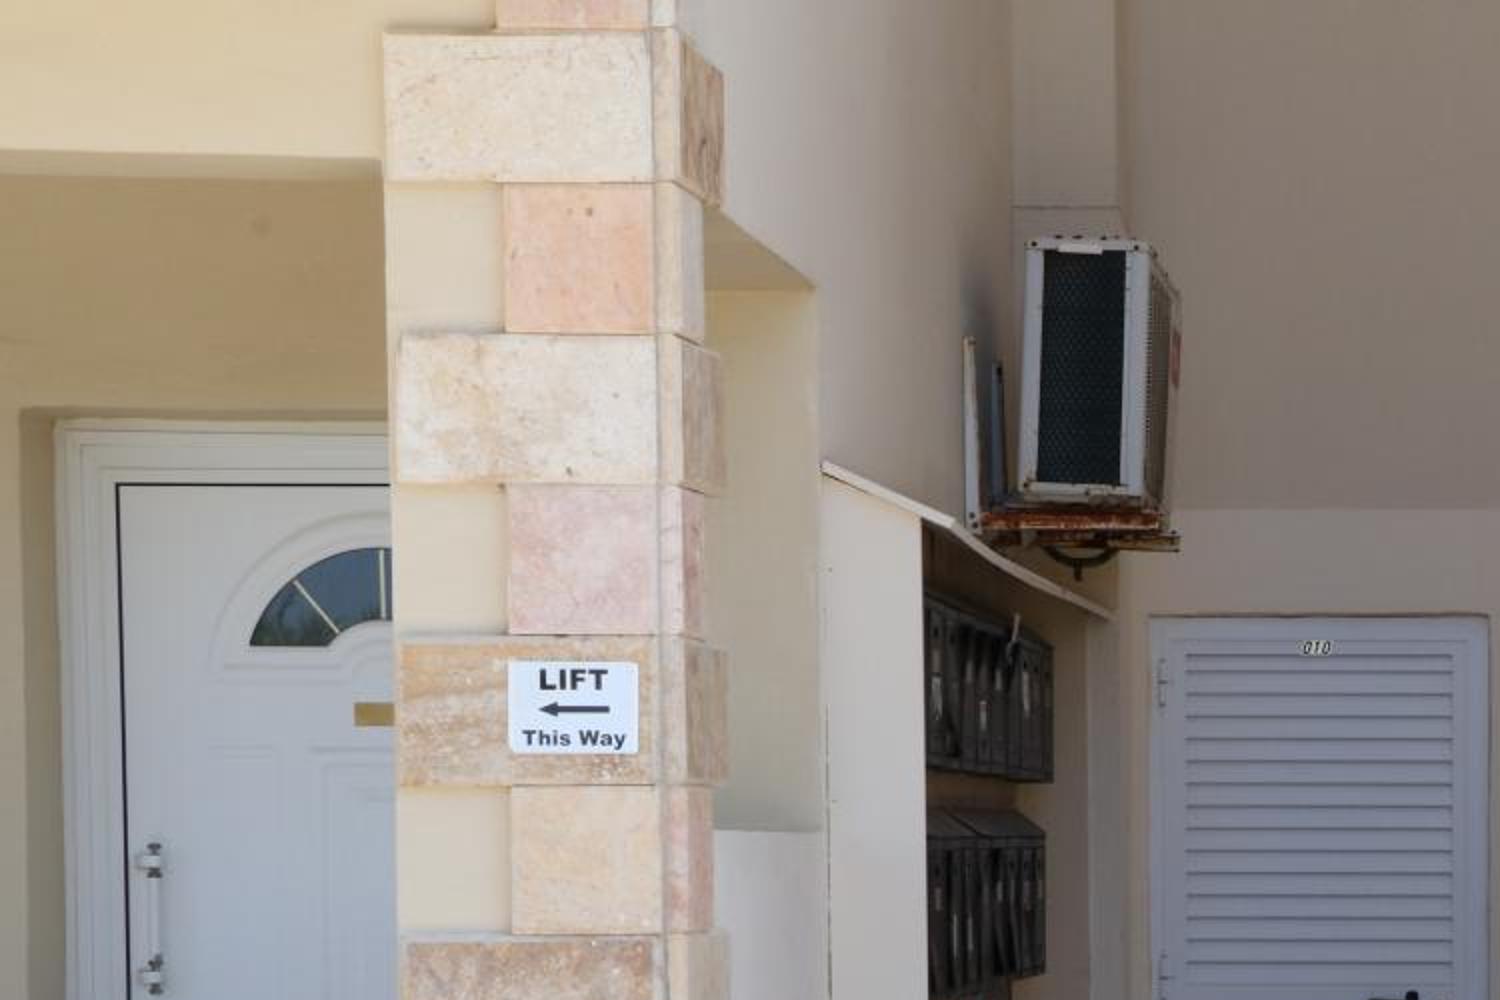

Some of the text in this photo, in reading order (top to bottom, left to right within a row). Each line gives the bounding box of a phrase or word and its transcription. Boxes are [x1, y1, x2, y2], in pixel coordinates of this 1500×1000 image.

[1303, 641, 1331, 655] 010
[539, 668, 608, 691] LIFT
[522, 729, 626, 750] This Way
